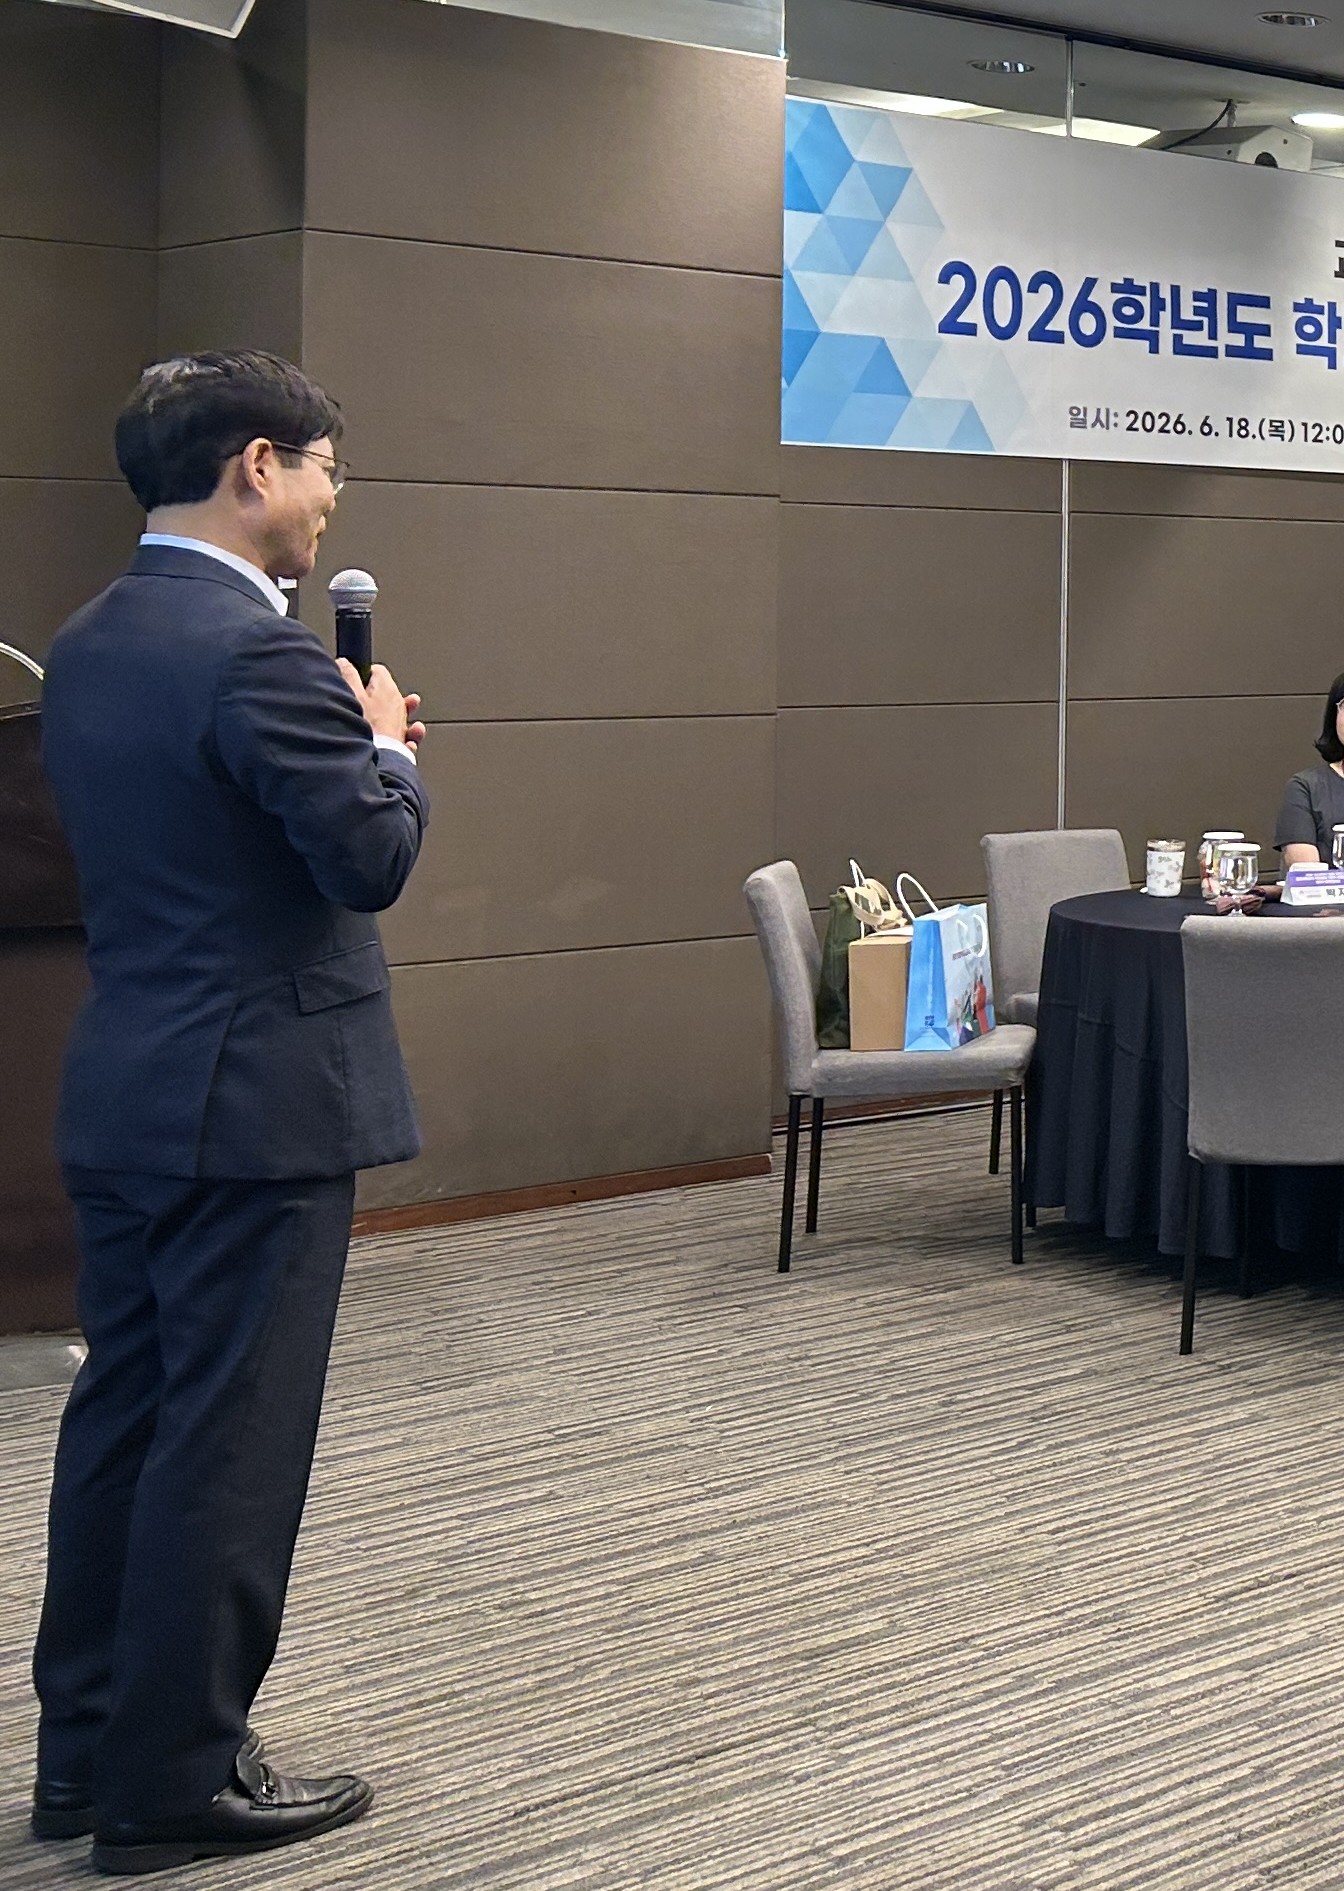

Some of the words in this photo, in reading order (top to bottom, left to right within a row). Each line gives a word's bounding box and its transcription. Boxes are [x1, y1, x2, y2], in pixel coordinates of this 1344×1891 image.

[937, 260, 1274, 362] 2026학년도
[1067, 405, 1120, 431] 일시:
[1124, 409, 1194, 436] 2026.
